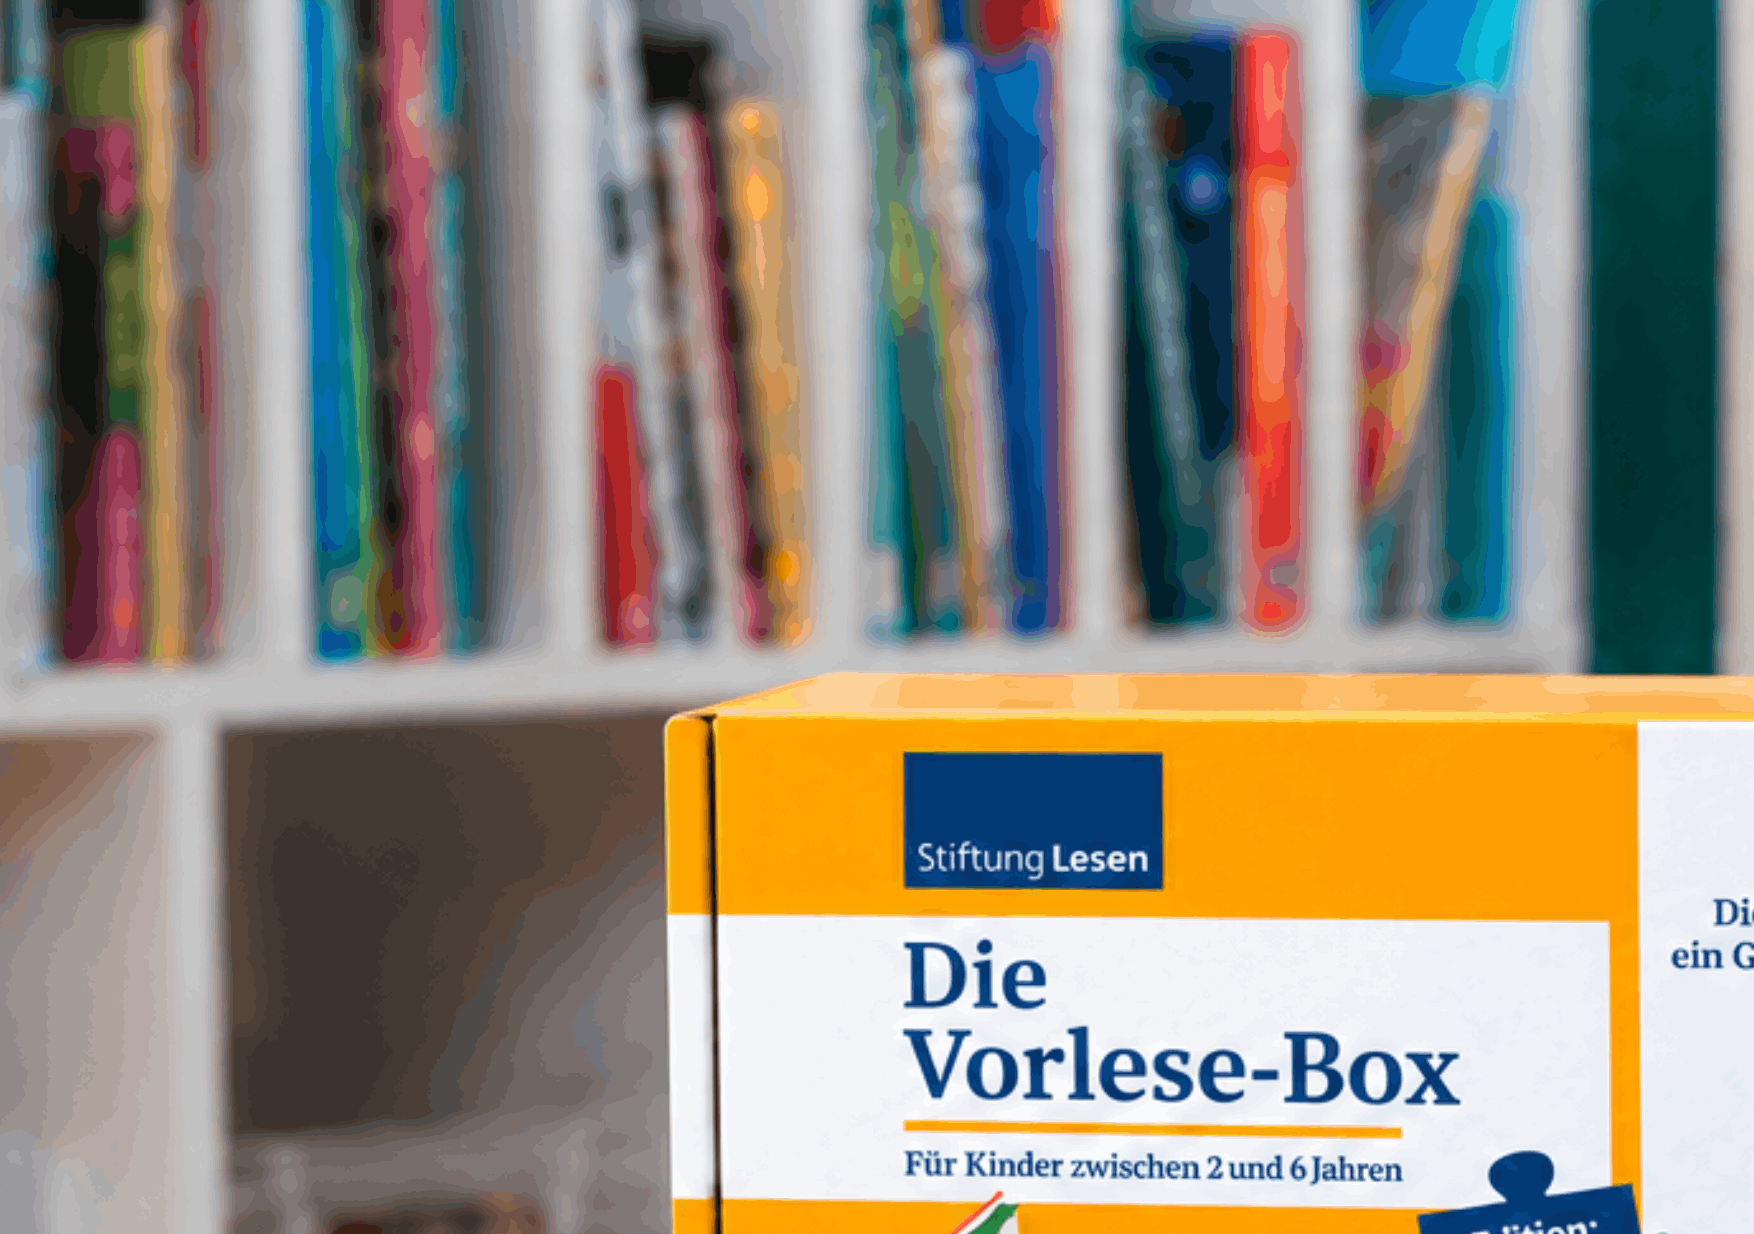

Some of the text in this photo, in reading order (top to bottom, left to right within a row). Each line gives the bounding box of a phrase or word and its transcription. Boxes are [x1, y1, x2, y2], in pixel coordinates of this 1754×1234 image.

[918, 841, 1148, 880] Stiftung Lesen
[903, 938, 1047, 1010] Die
[1671, 939, 1724, 970] ein
[902, 1025, 1461, 1106] Vorlese-Box
[905, 1150, 1403, 1185] Für Kinder zwischen 2 und 6 Jahren
